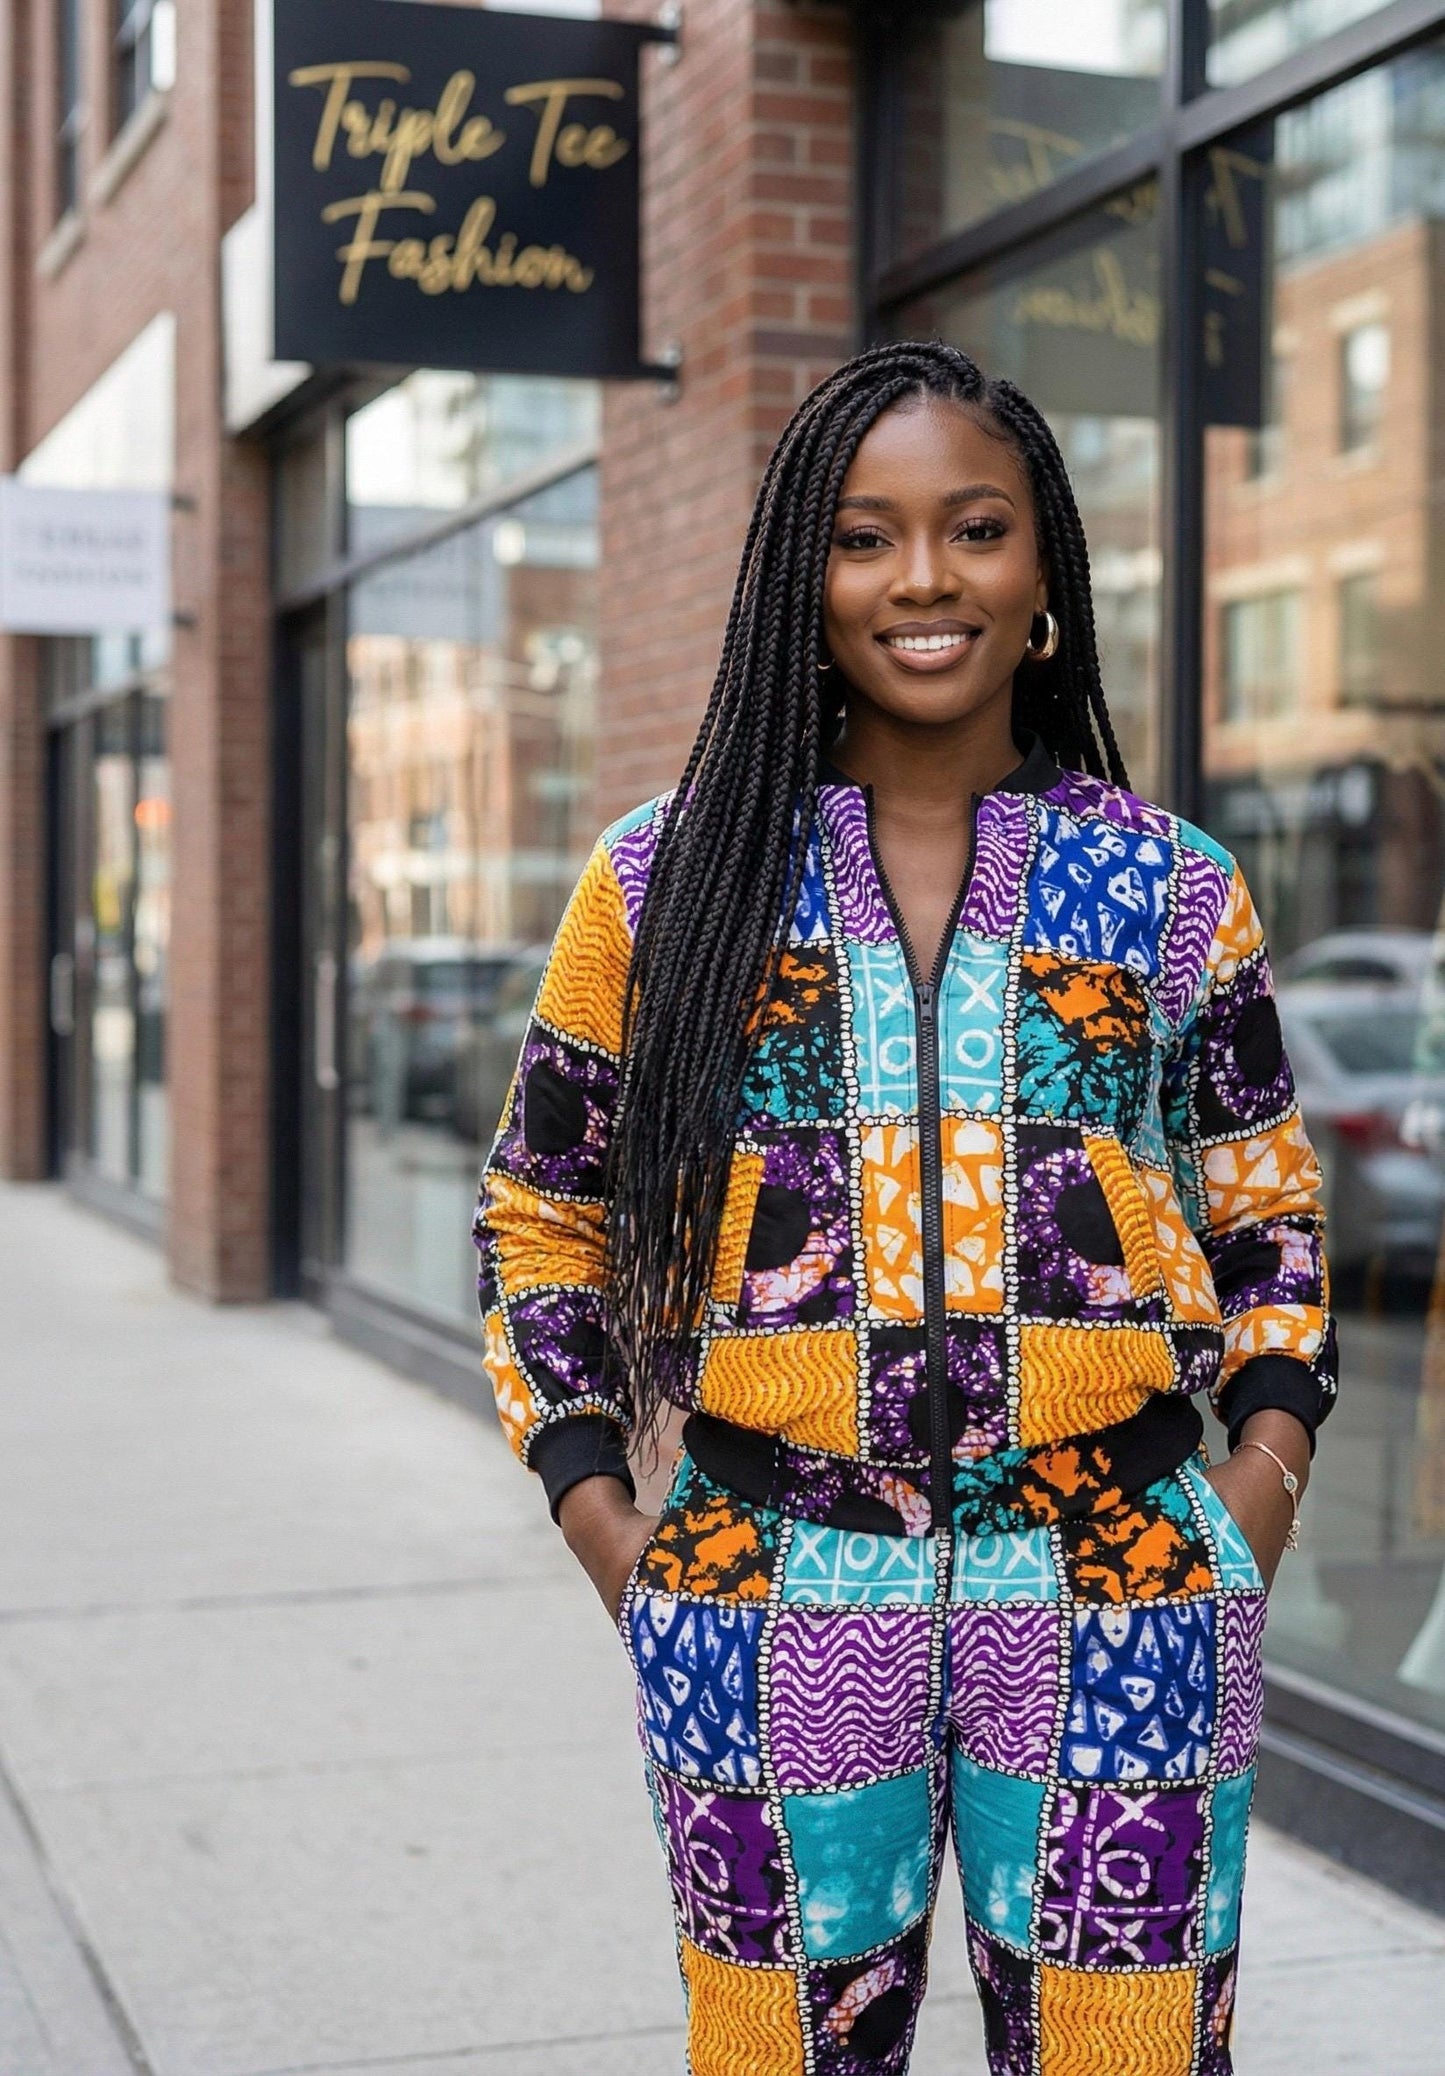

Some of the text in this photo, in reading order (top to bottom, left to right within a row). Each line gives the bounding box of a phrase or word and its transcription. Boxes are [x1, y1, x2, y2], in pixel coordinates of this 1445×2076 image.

[289, 61, 630, 193] Triple Tee
[320, 192, 595, 305] Fashion
